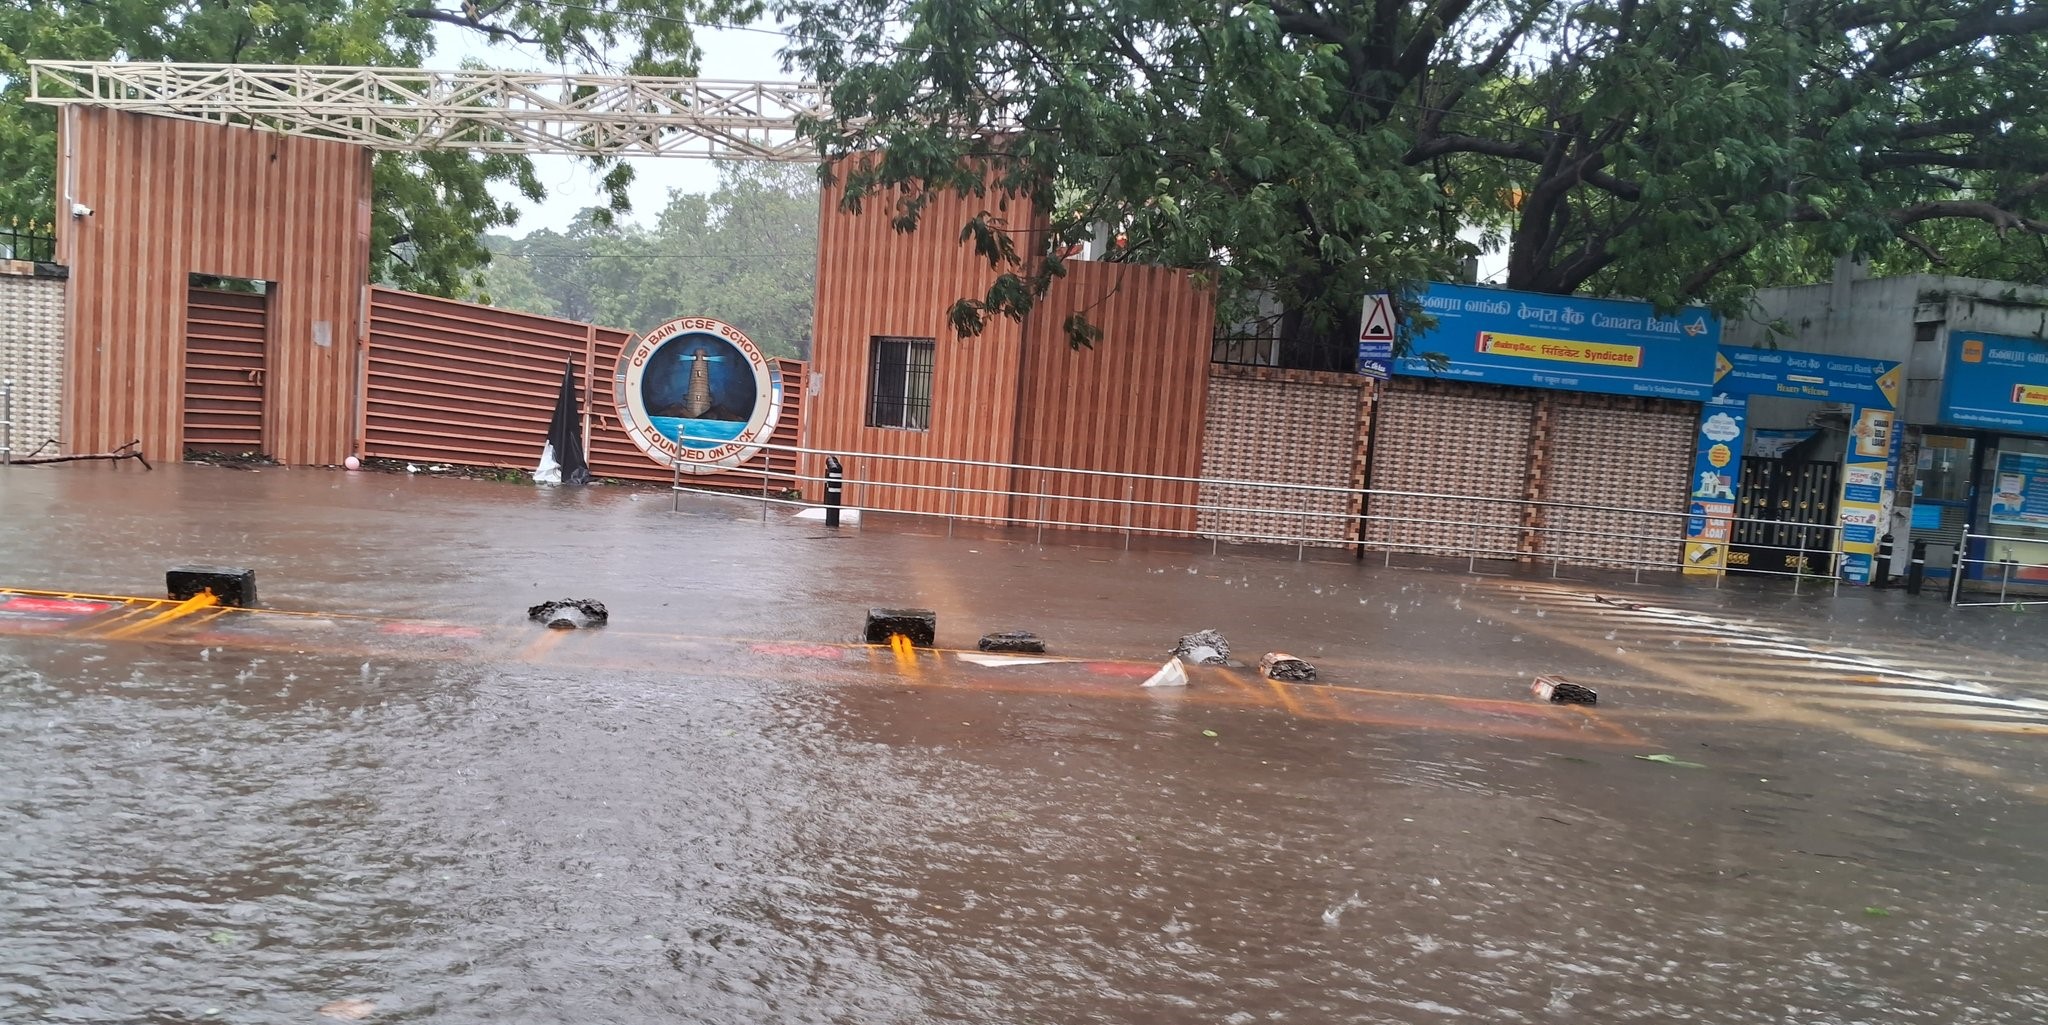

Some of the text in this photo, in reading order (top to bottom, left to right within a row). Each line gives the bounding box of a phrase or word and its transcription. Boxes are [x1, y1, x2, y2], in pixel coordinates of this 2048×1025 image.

[1517, 302, 1585, 324] केनरा बैंक
[1591, 312, 1681, 334] Canara Bank
[633, 319, 761, 371] CSI BAIN ICSE SCHOOL
[1584, 349, 1634, 363] Syndicate
[1827, 361, 1872, 374] Canara Bank
[1633, 383, 1700, 397] Bain's School Branch
[708, 447, 725, 459] ON
[1705, 504, 1732, 514] CANARA
